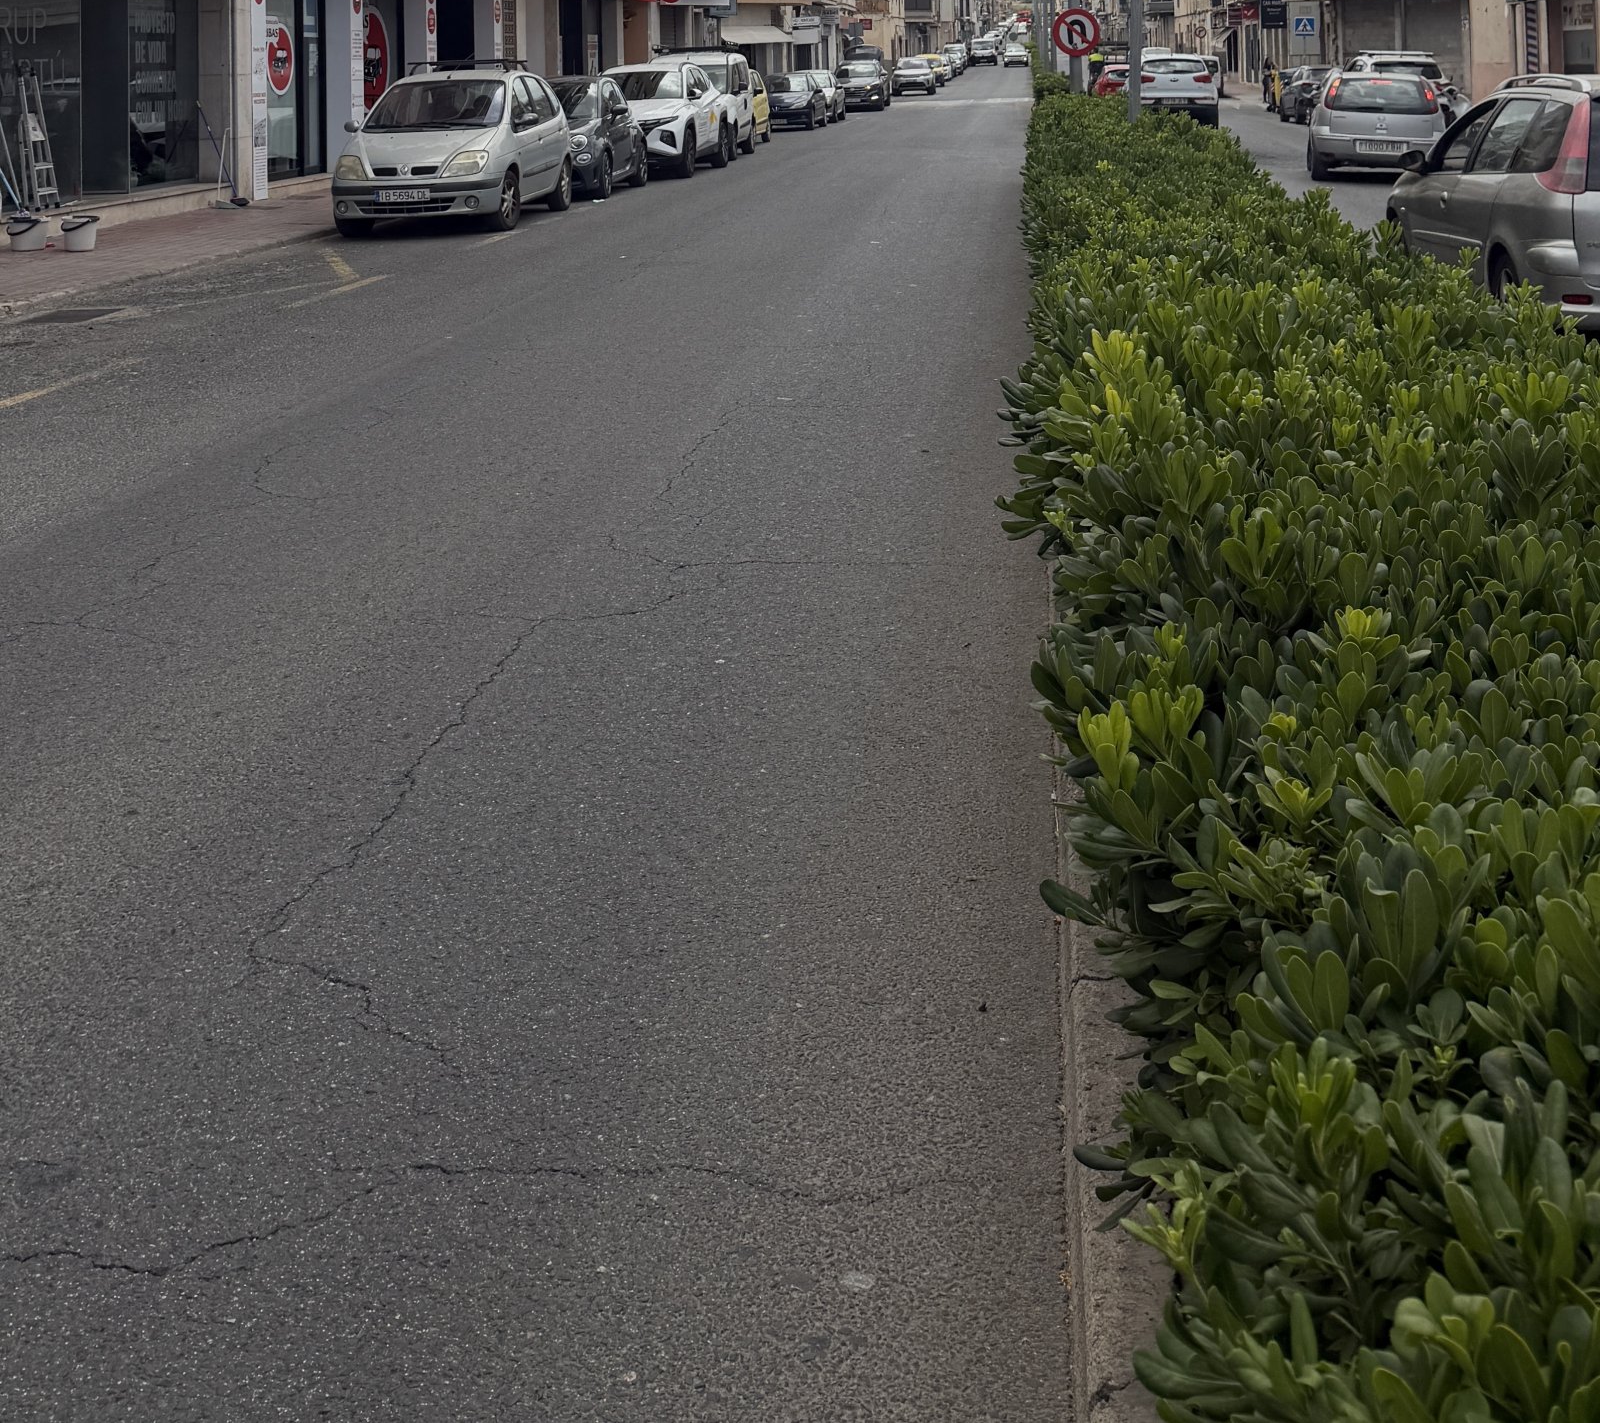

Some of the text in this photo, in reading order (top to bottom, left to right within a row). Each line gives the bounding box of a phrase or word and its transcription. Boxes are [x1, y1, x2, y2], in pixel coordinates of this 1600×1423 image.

[0, 7, 47, 45] RUP
[134, 9, 176, 35] PROYECTO
[135, 40, 167, 64] DE VIDA
[392, 191, 415, 201] 5694
